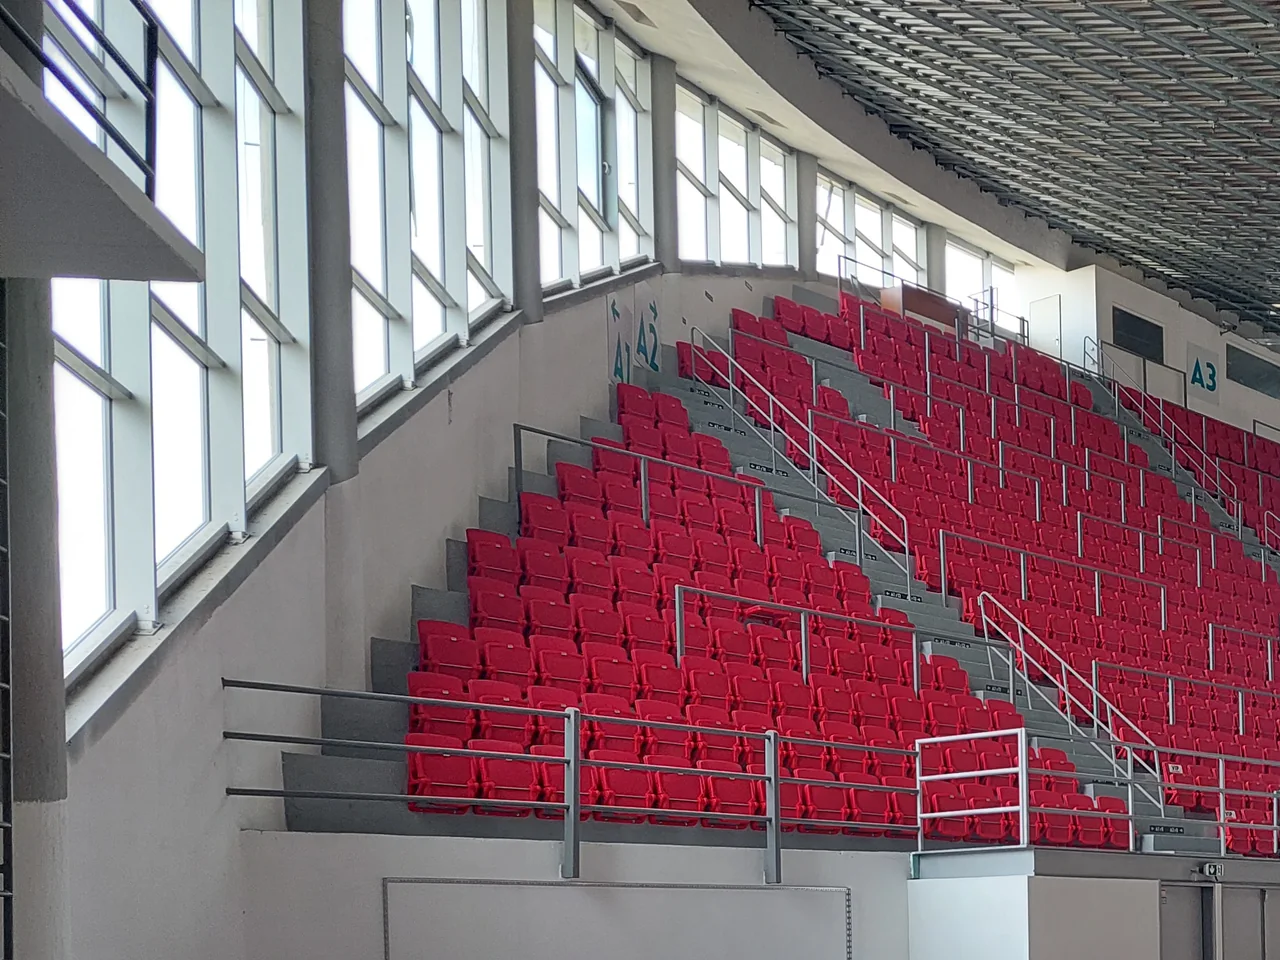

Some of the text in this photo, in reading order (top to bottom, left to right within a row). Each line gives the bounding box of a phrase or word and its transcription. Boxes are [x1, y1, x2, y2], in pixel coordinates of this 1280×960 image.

[614, 332, 630, 384] A1
[636, 311, 659, 372] A2
[1190, 357, 1217, 392] A3
